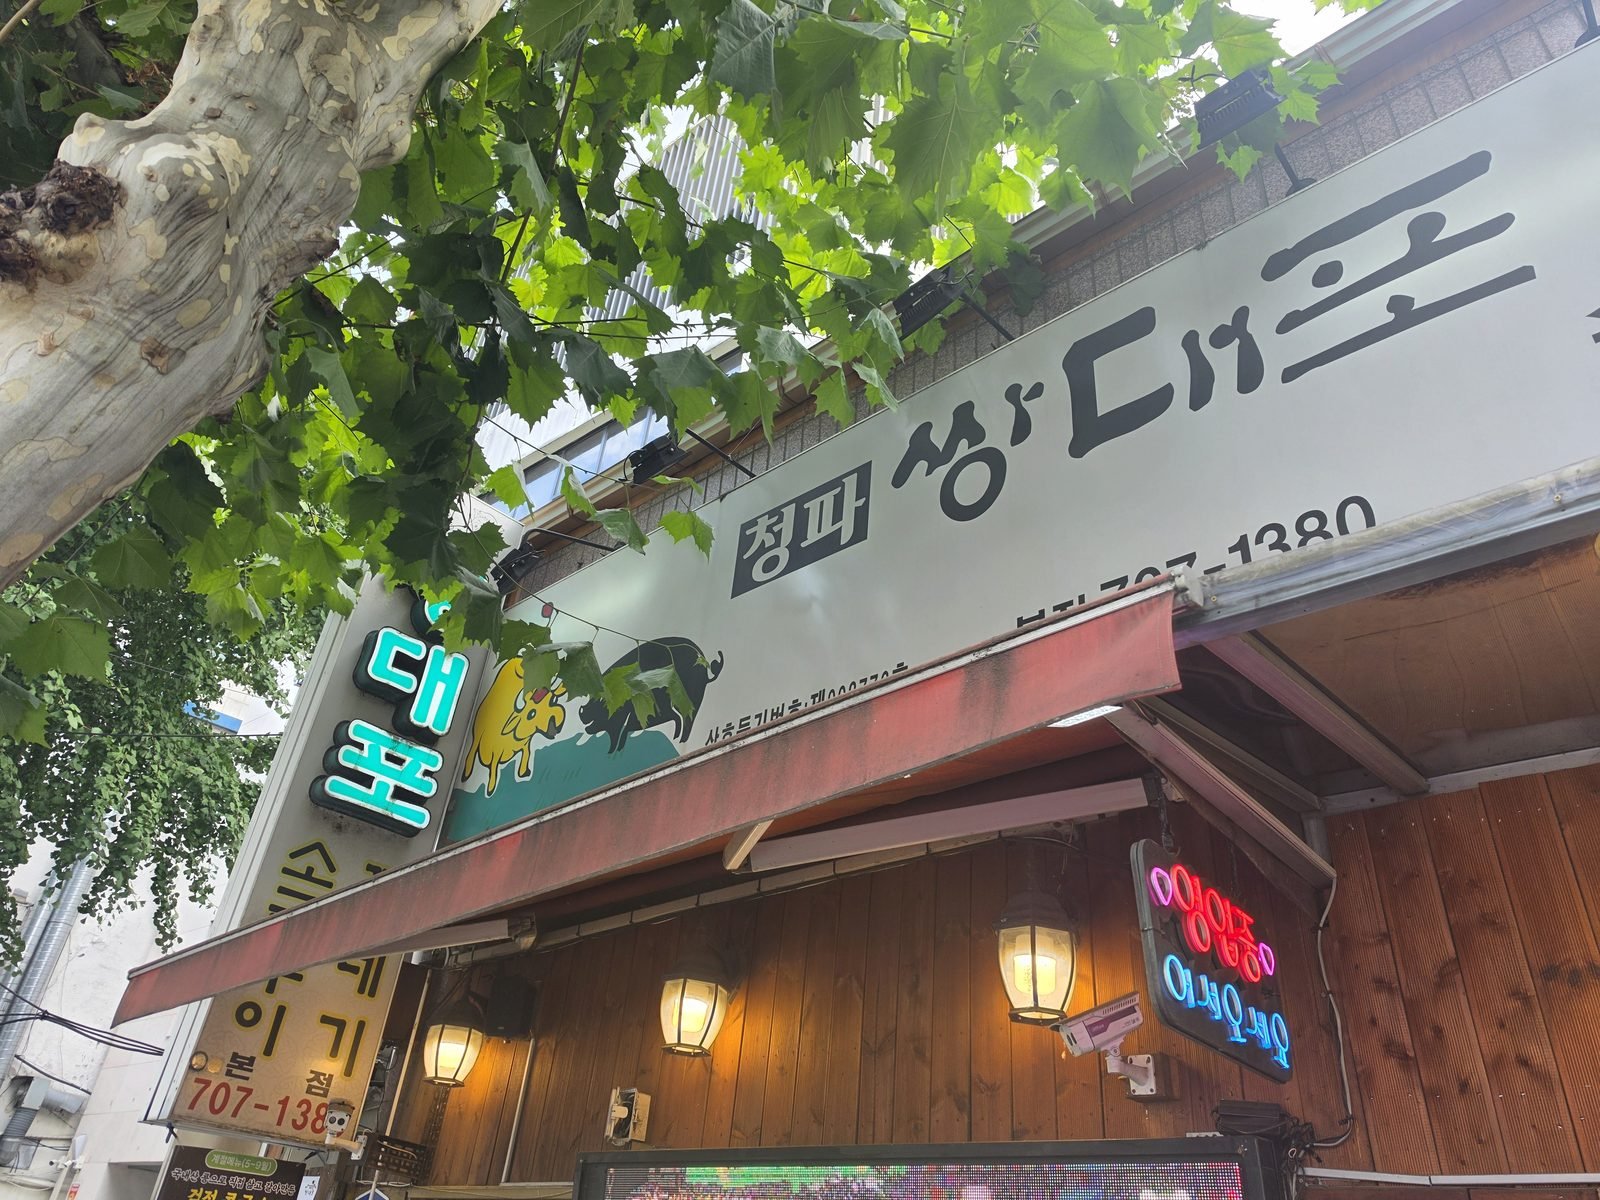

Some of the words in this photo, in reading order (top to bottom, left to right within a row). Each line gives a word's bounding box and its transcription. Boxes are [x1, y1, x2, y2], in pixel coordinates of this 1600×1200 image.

[743, 472, 867, 583] 청파
[891, 150, 1536, 522] 쌍대포
[324, 600, 470, 830] 대포
[1170, 864, 1261, 983] 영업중
[1163, 954, 1290, 1069] 어서오세요
[187, 1077, 345, 1138] 707-138
[171, 1167, 200, 1183] 국내산
[229, 1176, 246, 1190] 직접
